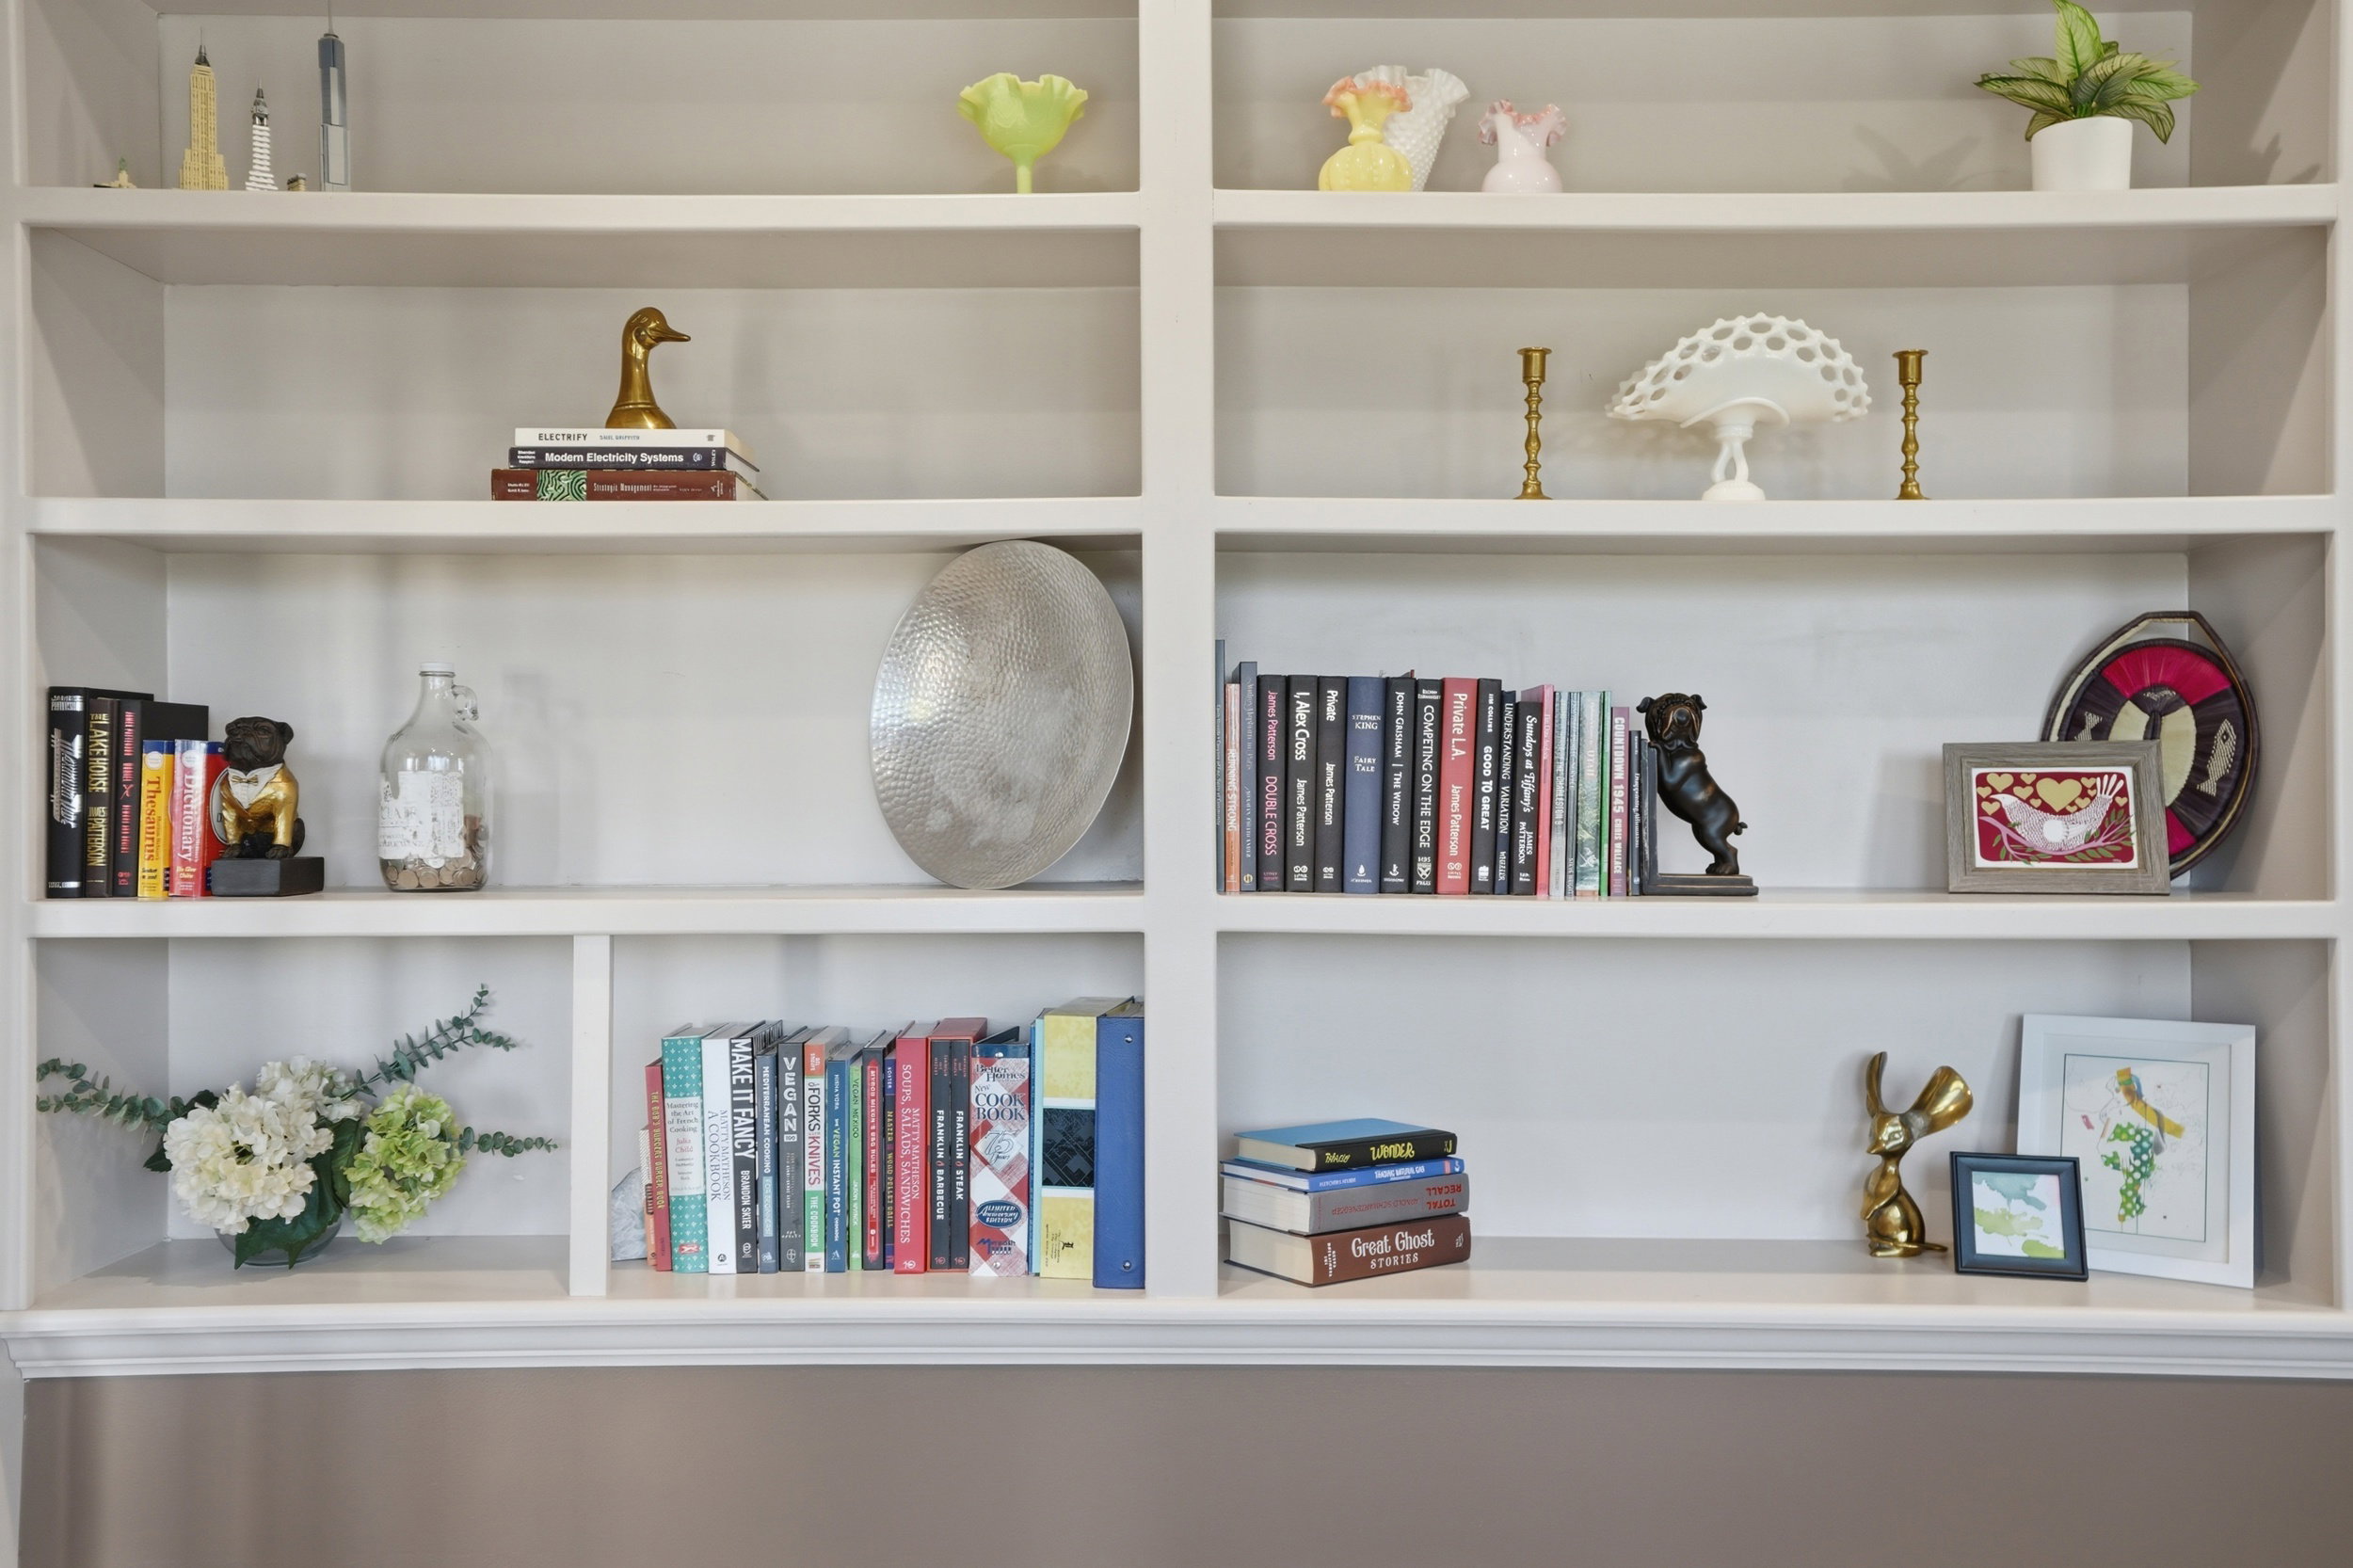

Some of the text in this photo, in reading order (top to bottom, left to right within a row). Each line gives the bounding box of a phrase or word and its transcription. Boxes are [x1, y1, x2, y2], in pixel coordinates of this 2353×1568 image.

[538, 433, 588, 441] ELECTRIFY
[545, 453, 684, 464] Modern Electricity Systems
[593, 483, 652, 493] Strategic Management
[1267, 690, 1279, 760] James Patterson
[1295, 700, 1310, 727] Alex
[1326, 690, 1338, 722] Private
[1450, 693, 1468, 760] Private L.A.
[89, 720, 110, 756] LAKE
[1294, 728, 1309, 760] Cross
[1392, 692, 1405, 825] JOHN GRISHAM THE WIDOW
[88, 757, 108, 792] HOUSE
[1227, 748, 1238, 791] RUNNING
[1355, 763, 1375, 772] TALE
[1419, 704, 1434, 849] COMPETING ON THE EDGE
[1499, 703, 1513, 834] UNDERSTANDING VARIATION
[1521, 715, 1537, 812] Sundays at Tiffany's
[1324, 762, 1336, 825] James Patterson
[1481, 745, 1493, 830] GOOD TO GREAT
[1555, 776, 1565, 819] CHARLESTON
[1612, 717, 1625, 873] COUNTDOWN 1945 CHRIS WALLACE
[145, 776, 162, 861] Thesaurus
[177, 773, 199, 863] Dictionary
[1226, 792, 1237, 832] STRONG
[1265, 776, 1277, 856] DOUBLE CROSS
[1296, 778, 1307, 846] James Patterson
[1449, 784, 1463, 856] James Patterson
[87, 818, 107, 867] PATTERSON
[1518, 821, 1527, 865] PATTERSON
[976, 1064, 1008, 1074] Better
[986, 1072, 1025, 1081] Homes
[650, 1091, 660, 1104] THE
[666, 1102, 699, 1112] Mastering
[730, 1038, 755, 1159] MAKE IT FANCY
[762, 1065, 771, 1135] MEDITERRANEAN
[783, 1057, 797, 1131] VEGAN
[975, 1093, 1025, 1107] COOK
[975, 1107, 1025, 1121] BOOK
[708, 1110, 721, 1202] A COOKBOOK
[719, 1110, 731, 1201] MATTY MATHESON
[762, 1137, 771, 1173] COOKING
[808, 1086, 821, 1185] FORKS KNIVES
[832, 1128, 840, 1158] VEGAN
[900, 1064, 911, 1243] SOUPS, SALADS, SANDWICHES
[911, 1108, 920, 1200] MATTY MATHESON
[1370, 1142, 1415, 1160] WONDER
[832, 1160, 840, 1195] INSTANT
[936, 1169, 944, 1220] BARBECUE
[1426, 1184, 1462, 1196] RECALL
[741, 1170, 752, 1230] BRANDON SKIER
[808, 1195, 819, 1247] THE COOKBOOK
[1427, 1198, 1456, 1210] TOTAL
[1352, 1229, 1434, 1257] Great Ghost
[1370, 1253, 1418, 1269] STORIES
